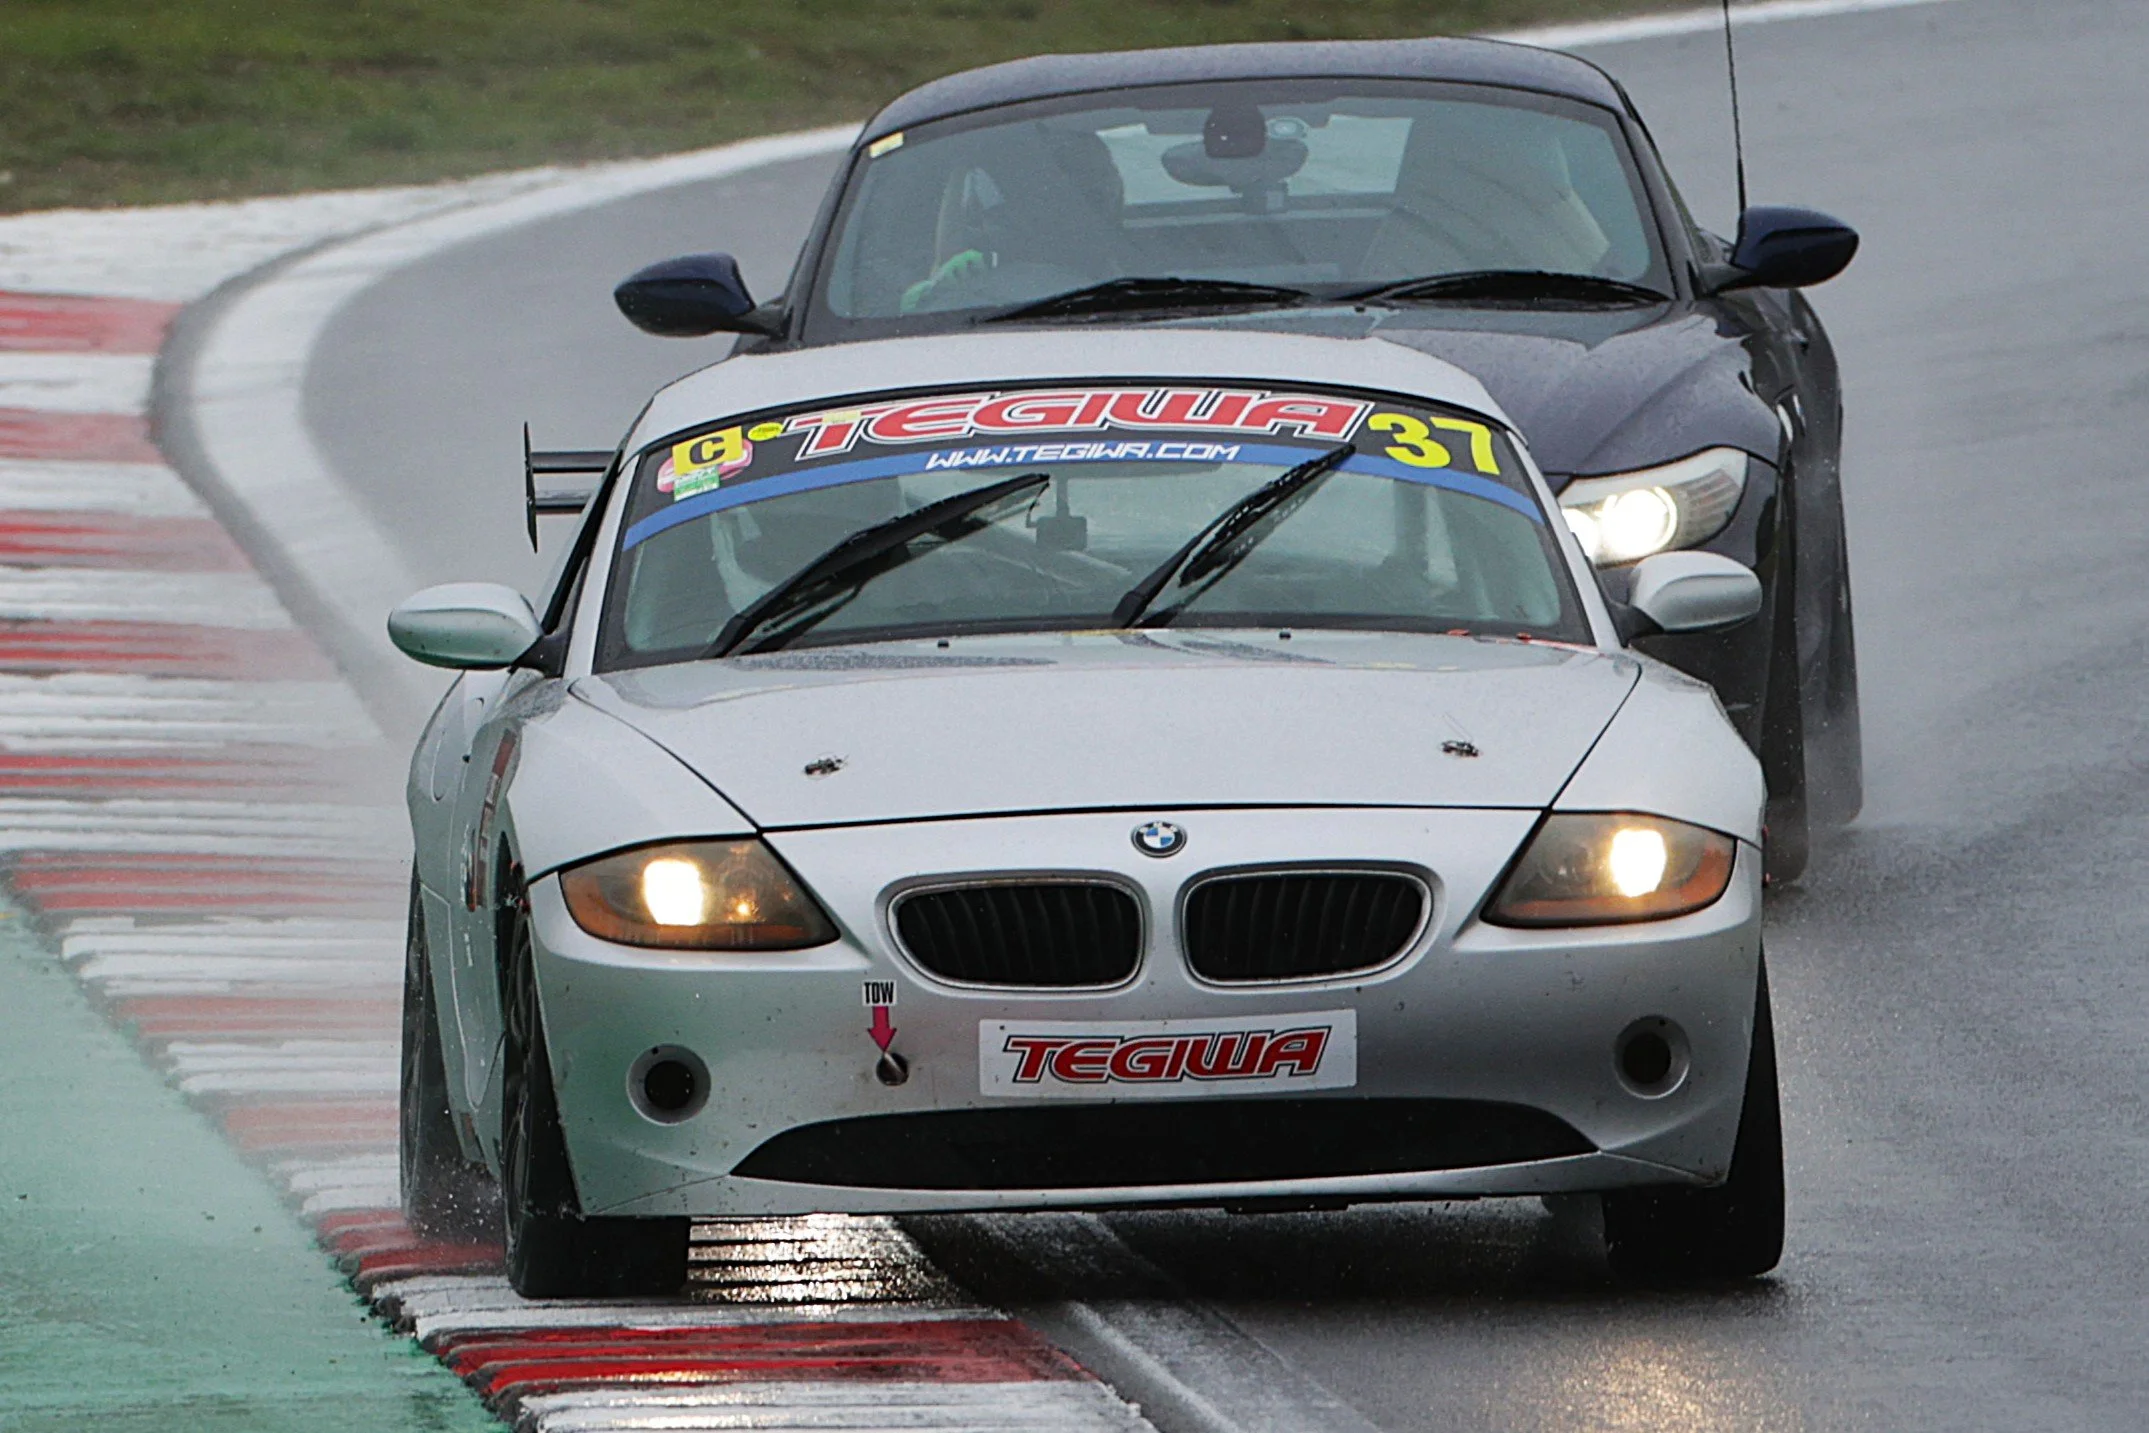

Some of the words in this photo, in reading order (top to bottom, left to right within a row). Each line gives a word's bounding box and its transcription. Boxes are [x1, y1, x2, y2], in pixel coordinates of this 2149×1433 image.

[783, 389, 1374, 461] TEGIWA
[1368, 412, 1500, 475] 37
[689, 436, 725, 465] C
[925, 443, 1240, 470] WWW.TEGIWA.COM
[864, 982, 894, 1004] TOW
[1003, 1026, 1332, 1084] TEGIWA
